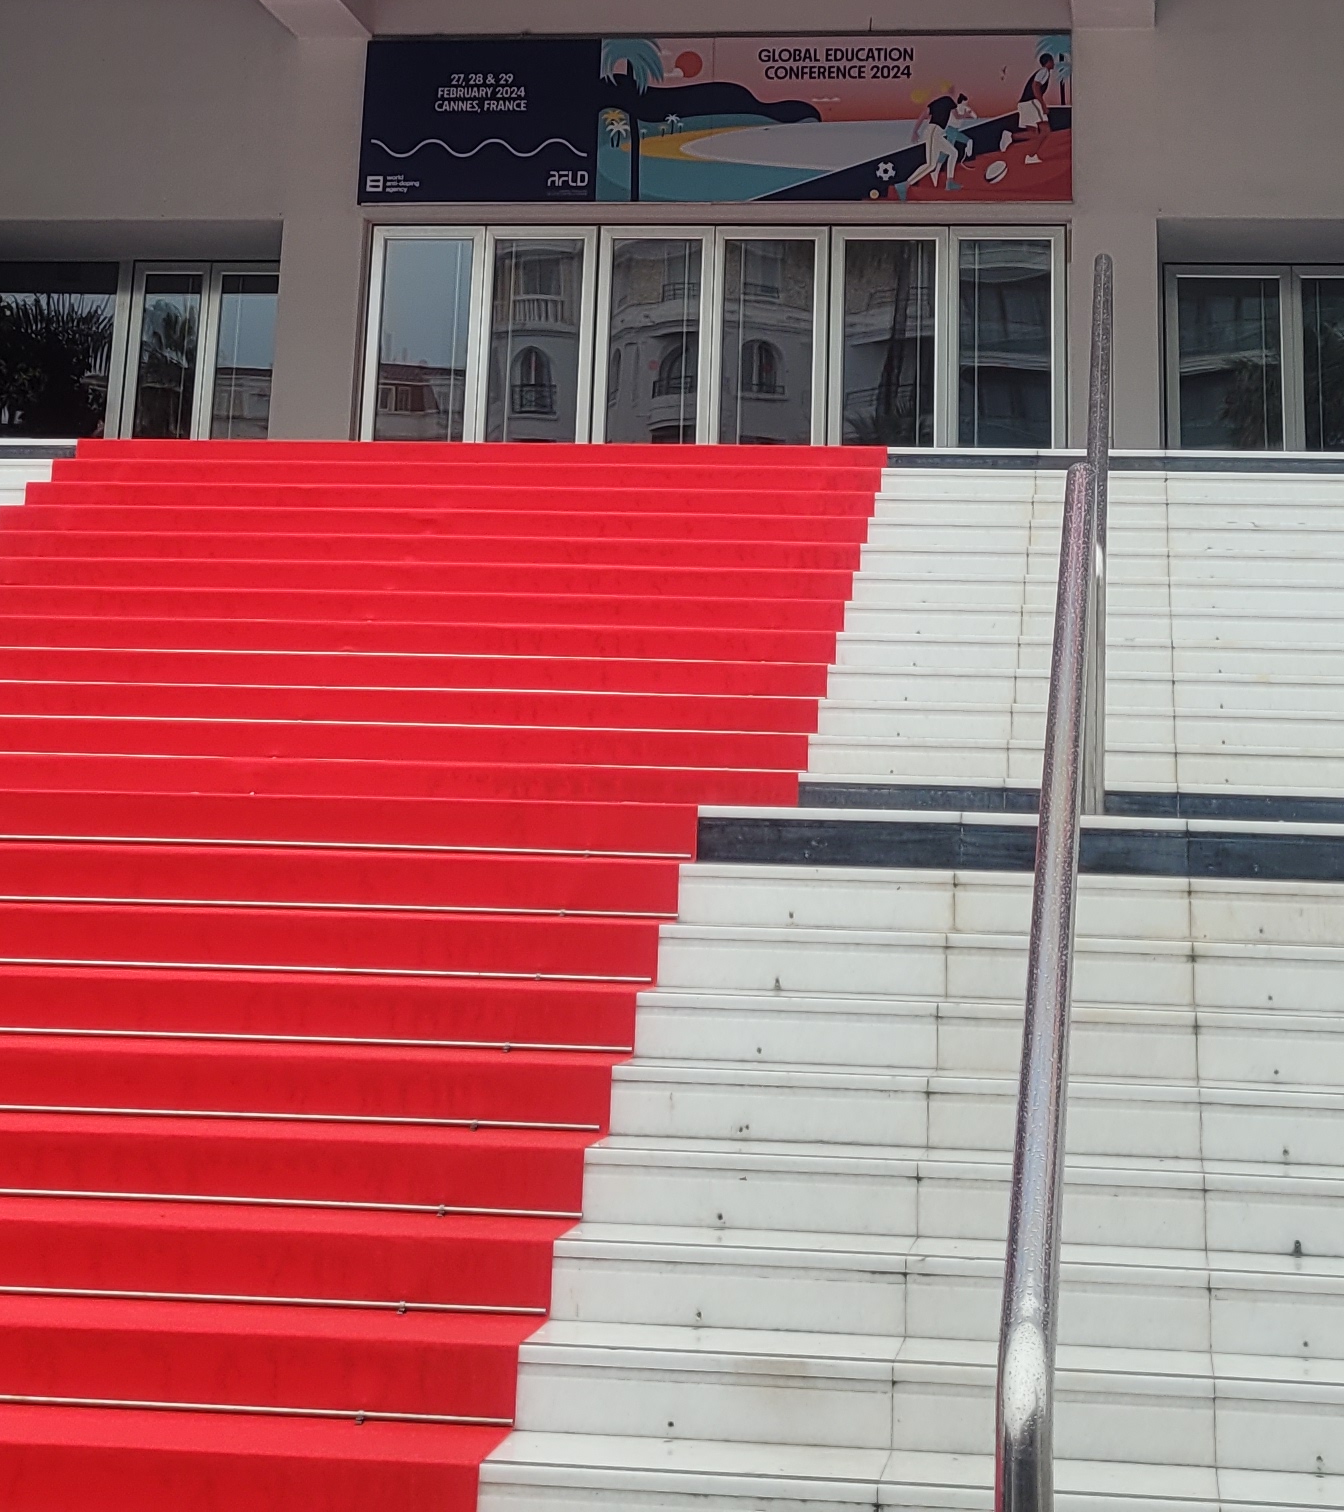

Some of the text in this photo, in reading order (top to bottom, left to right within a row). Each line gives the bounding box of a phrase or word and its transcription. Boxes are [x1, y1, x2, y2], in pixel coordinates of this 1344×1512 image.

[758, 47, 914, 63] GLOBAL EDUCATION
[764, 64, 912, 80] CONFERENCE 2024
[450, 73, 514, 86] 27, 28 & 29
[437, 86, 526, 98] FEBRUARY 2024
[434, 100, 528, 113] CANNES, FRANCE
